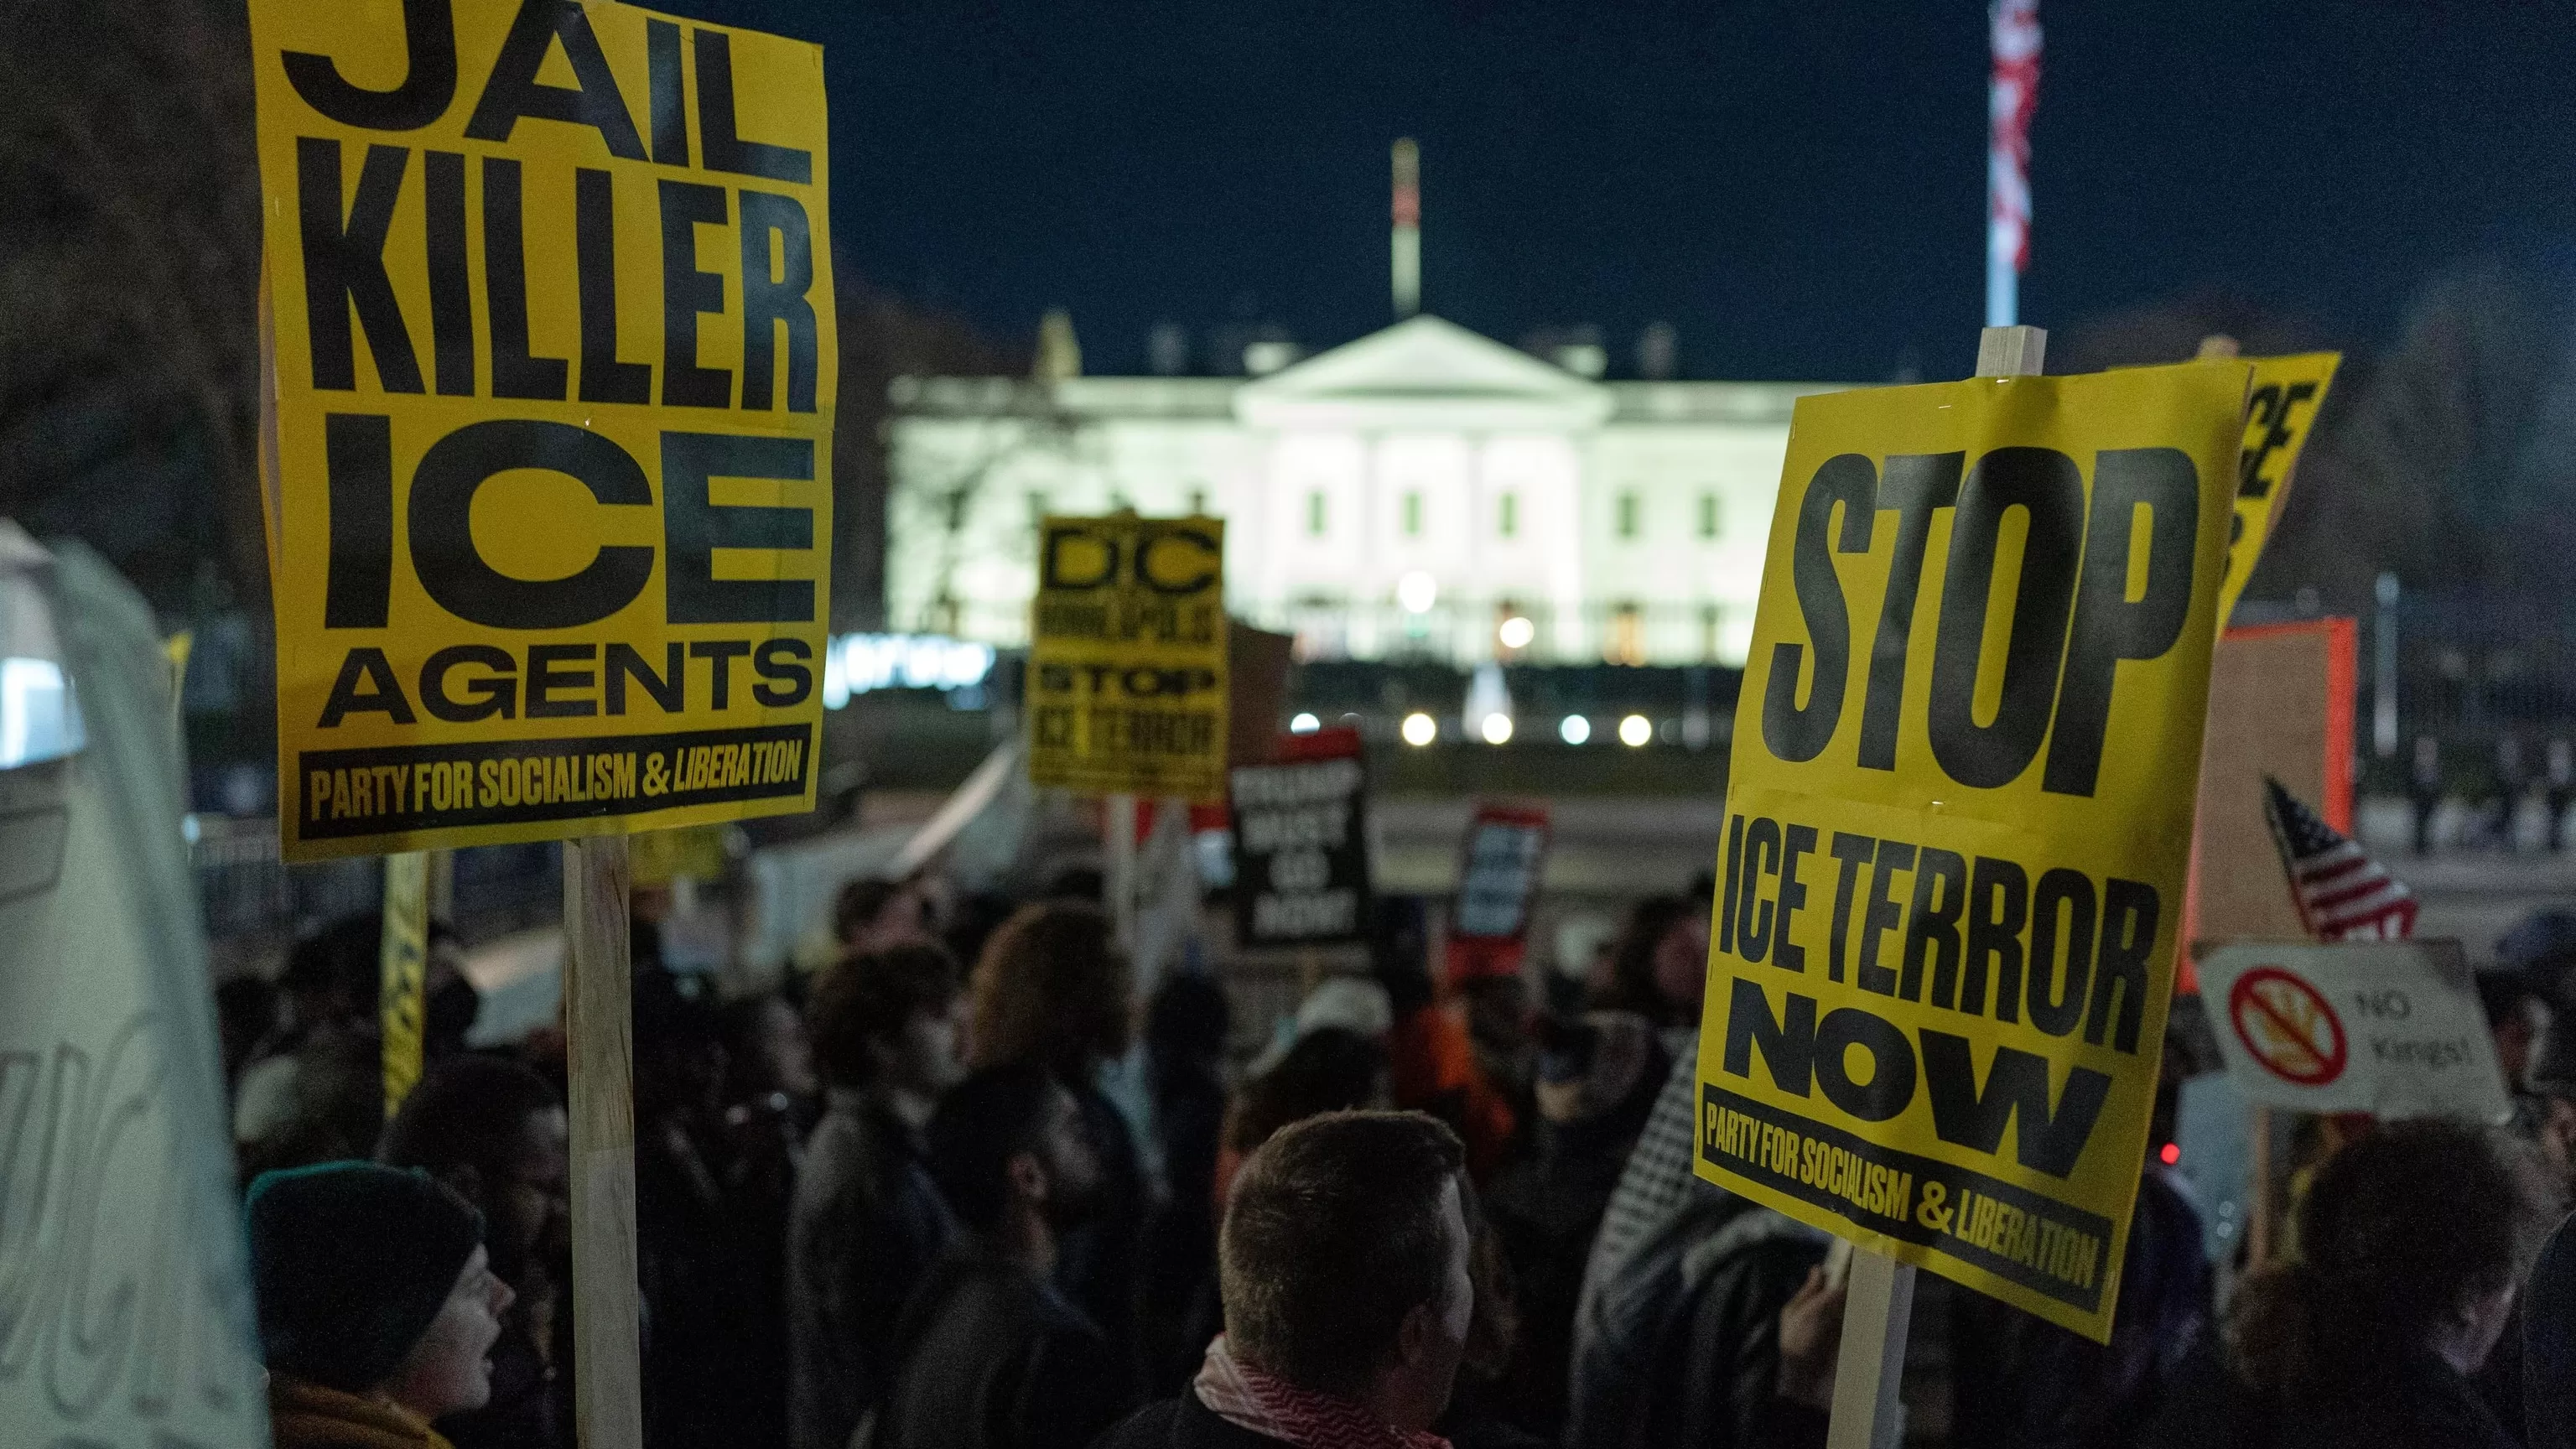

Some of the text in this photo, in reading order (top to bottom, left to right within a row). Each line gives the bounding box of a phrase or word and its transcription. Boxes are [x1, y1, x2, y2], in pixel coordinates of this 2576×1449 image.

[280, 0, 812, 185] JAIL
[296, 136, 818, 414] KILLER
[2236, 382, 2319, 499] CE
[325, 412, 815, 631] ICE
[1045, 528, 1219, 595] DC
[1762, 446, 2199, 798] STOP
[316, 637, 813, 729] AGENTS
[1036, 661, 1218, 701] STOP
[311, 739, 802, 823] PARTY FOR SOCIALISM & LIBERATION
[1232, 763, 1358, 808] TRUMP
[1244, 808, 1348, 850] MUST
[1274, 852, 1326, 891] GO
[1719, 814, 2160, 1056] ICE TERROR
[2354, 989, 2412, 1021] NO
[1722, 975, 2112, 1180] NOW
[1706, 1101, 2101, 1290] PARTY FOR SOCIALISM & LIBERATION
